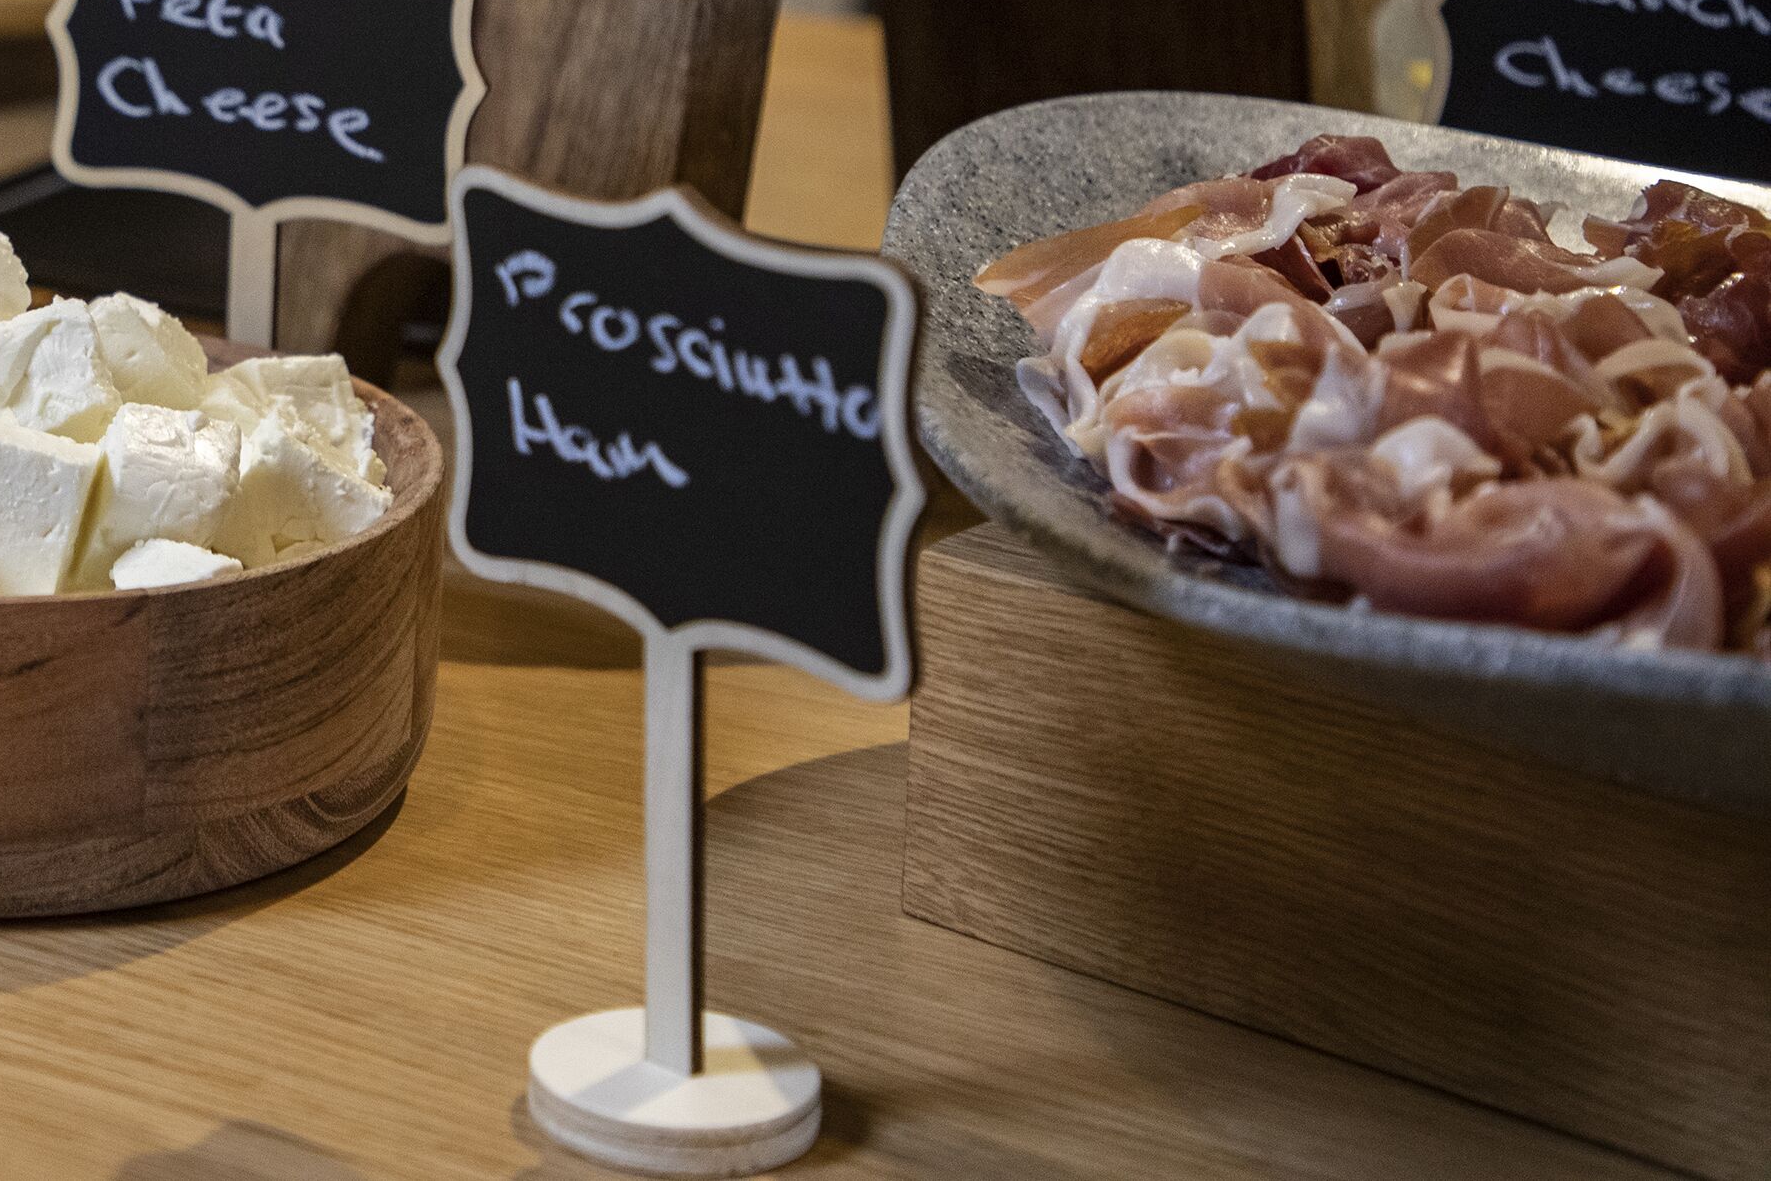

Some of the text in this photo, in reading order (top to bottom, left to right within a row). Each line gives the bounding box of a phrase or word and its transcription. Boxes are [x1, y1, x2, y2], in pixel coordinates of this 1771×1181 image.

[95, 55, 386, 163] Cheese
[494, 249, 883, 440] Prosciutto
[506, 376, 690, 489] Ham
